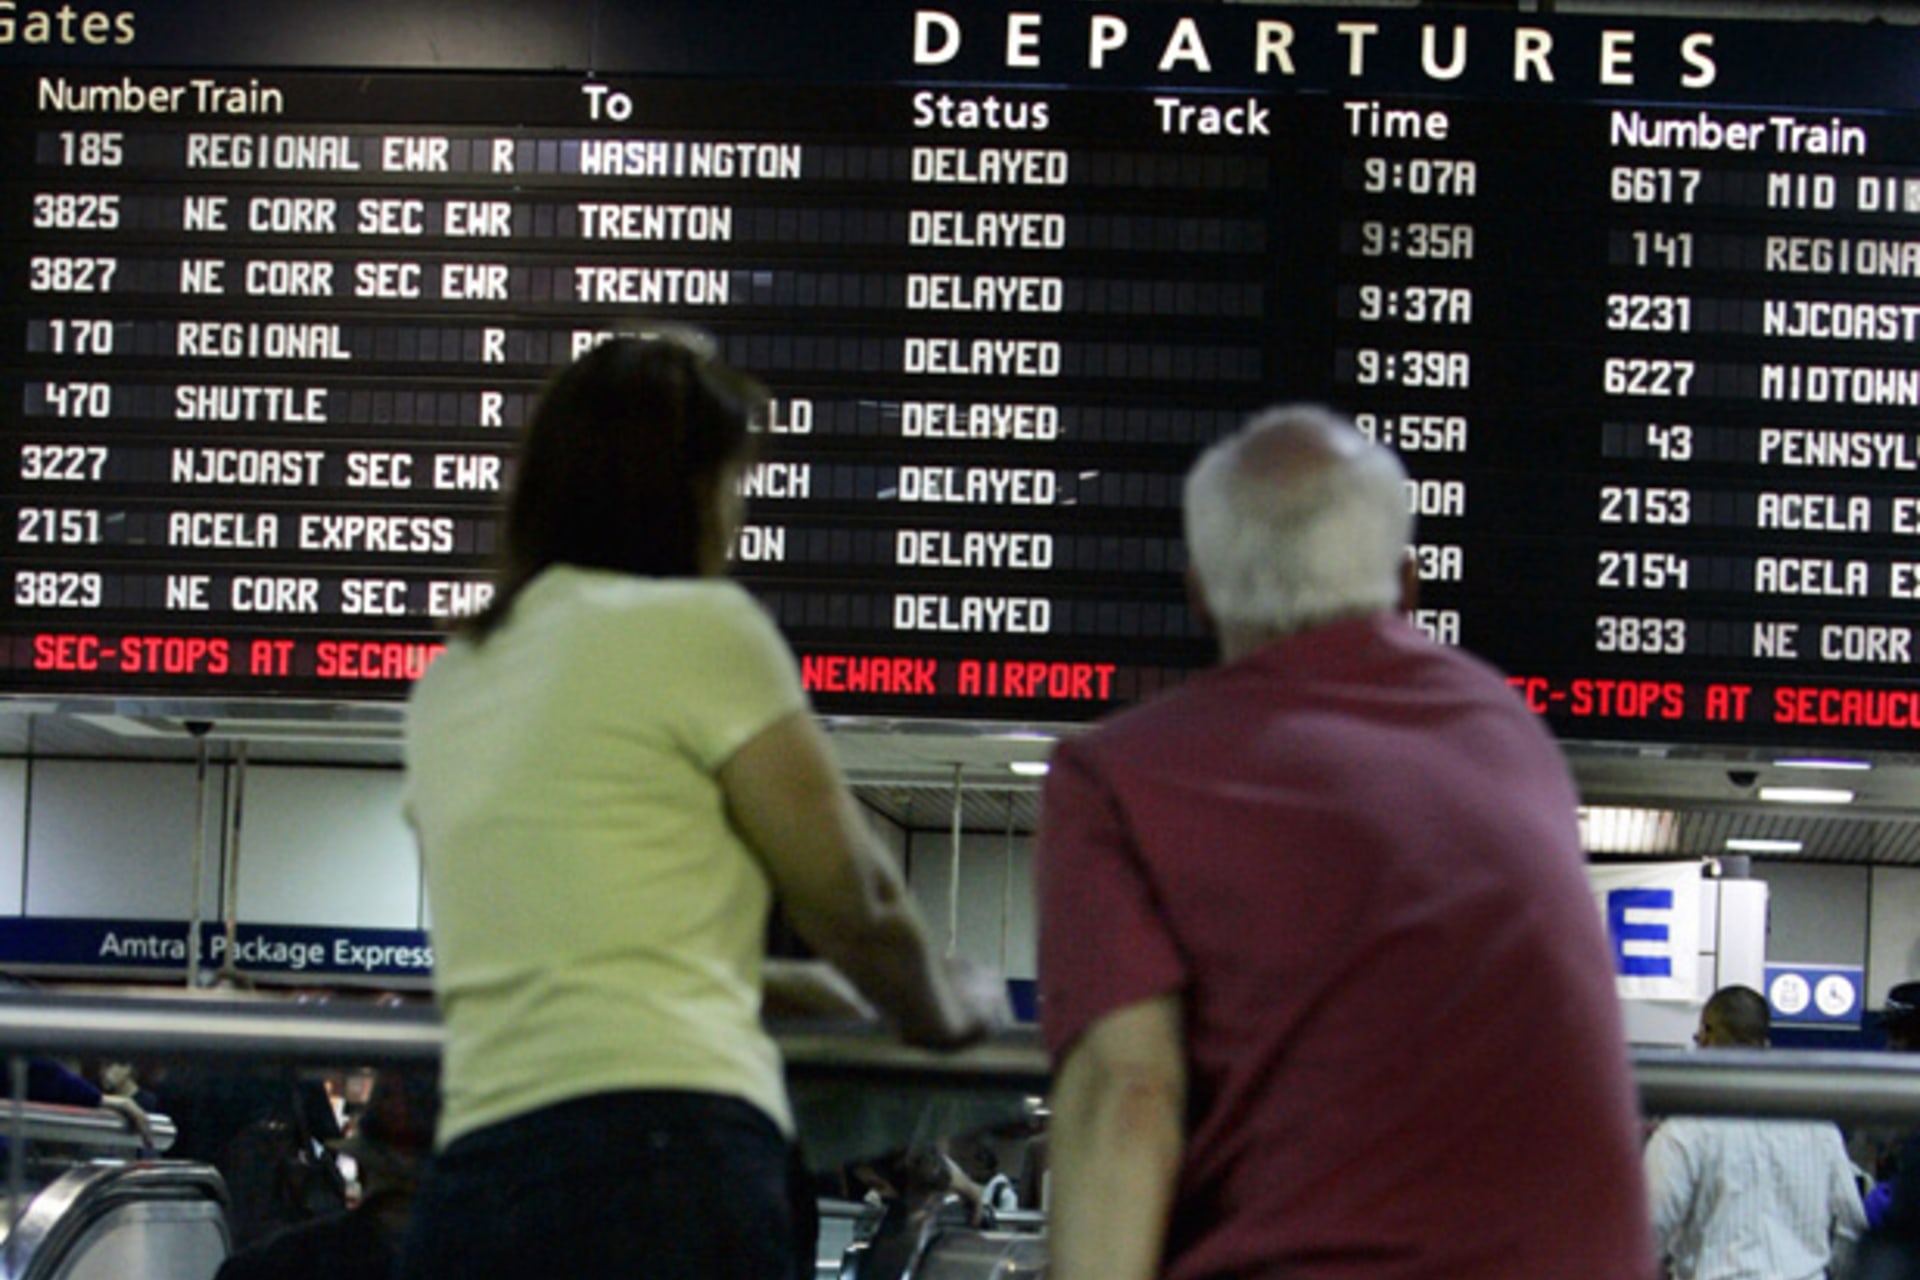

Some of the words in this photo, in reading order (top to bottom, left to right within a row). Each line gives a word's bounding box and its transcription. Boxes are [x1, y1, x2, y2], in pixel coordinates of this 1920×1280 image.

[0, 0, 135, 44] Gates
[914, 10, 1716, 88] DEPARTURES
[39, 76, 186, 113] Number
[190, 79, 283, 113] Train
[582, 85, 632, 121] To
[913, 91, 1049, 130] Status
[1154, 97, 1270, 135] Track
[1344, 101, 1449, 140] Time
[1611, 110, 1766, 150] Number
[1769, 116, 1866, 155] Train
[60, 132, 123, 166] 185
[187, 133, 361, 171] REGIONAL
[382, 136, 449, 172] EWR
[492, 138, 514, 173] R
[579, 140, 801, 179] WASHINGTON
[911, 147, 1068, 185] DELAYED
[1365, 158, 1476, 196] 9:07A
[1611, 166, 1701, 204] 6617
[1768, 173, 1836, 209] MID
[33, 194, 119, 229] 3825
[183, 196, 228, 231] NE
[249, 197, 337, 233] CORR
[357, 199, 424, 235] SEC
[444, 201, 511, 237] EWR
[578, 203, 731, 241] TRENTON
[909, 210, 1065, 249] DELAYED
[1362, 223, 1473, 259] 9:35A
[1633, 231, 1692, 268] 141
[1766, 237, 1920, 278] REGIONA
[30, 257, 117, 292] 3827
[180, 260, 225, 294] NE
[245, 260, 334, 296] CORR
[355, 262, 421, 298] SEC
[441, 263, 508, 300] EWR
[575, 266, 729, 304] TRENTON
[906, 274, 1063, 312] DELAYED
[1360, 285, 1472, 324] 9:37A
[1607, 294, 1691, 332] 3231
[1763, 300, 1920, 341] NJCOAST
[50, 319, 113, 355] 170
[177, 322, 351, 359] REGIONAL
[483, 328, 505, 363] R
[904, 338, 1060, 376] DELAYED
[1357, 350, 1470, 388] 9:39A
[1604, 358, 1695, 396] 6227
[1761, 364, 1918, 406] MIDTOWN
[46, 382, 110, 418] 470
[175, 385, 328, 423] SHUTTLE
[480, 391, 503, 427] R
[901, 402, 1058, 440] DELAYED
[1355, 413, 1467, 452] 9:55A
[1647, 424, 1692, 461] 43
[1759, 428, 1920, 470] PENNSYL
[21, 445, 108, 481] 3227
[172, 448, 325, 486] NJCOAST
[347, 452, 412, 488] SEC
[433, 454, 500, 491] EWR
[898, 466, 1056, 505] DELAYED
[1600, 487, 1691, 525] 2153
[1757, 493, 1871, 532] ACELA
[1892, 498, 1920, 534] E
[17, 508, 99, 544] 2151
[169, 512, 278, 548] ACELA
[299, 515, 453, 553] EXPRESS
[896, 530, 1053, 569] DELAYED
[15, 571, 102, 607] 3829
[166, 575, 210, 610] NE
[231, 577, 319, 613] CORR
[341, 579, 407, 615] SEC
[428, 581, 495, 617] EWR
[894, 594, 1051, 633] DELAYED
[1598, 551, 1688, 589] 2154
[1755, 557, 1869, 596] ACELA
[1890, 562, 1920, 599] E
[1596, 616, 1686, 654] 3833
[1753, 622, 1798, 658] NE
[1821, 625, 1912, 663] CORR
[33, 634, 229, 674] SEC-STOPS
[250, 639, 295, 676] AT
[801, 655, 937, 695] NEWARK
[958, 659, 1115, 700] AIRPORT
[1505, 676, 1685, 721] C-STOPS
[1706, 684, 1751, 721] AT
[100, 932, 203, 960] Amtra
[333, 939, 434, 971] Express
[1607, 889, 1674, 978] E
